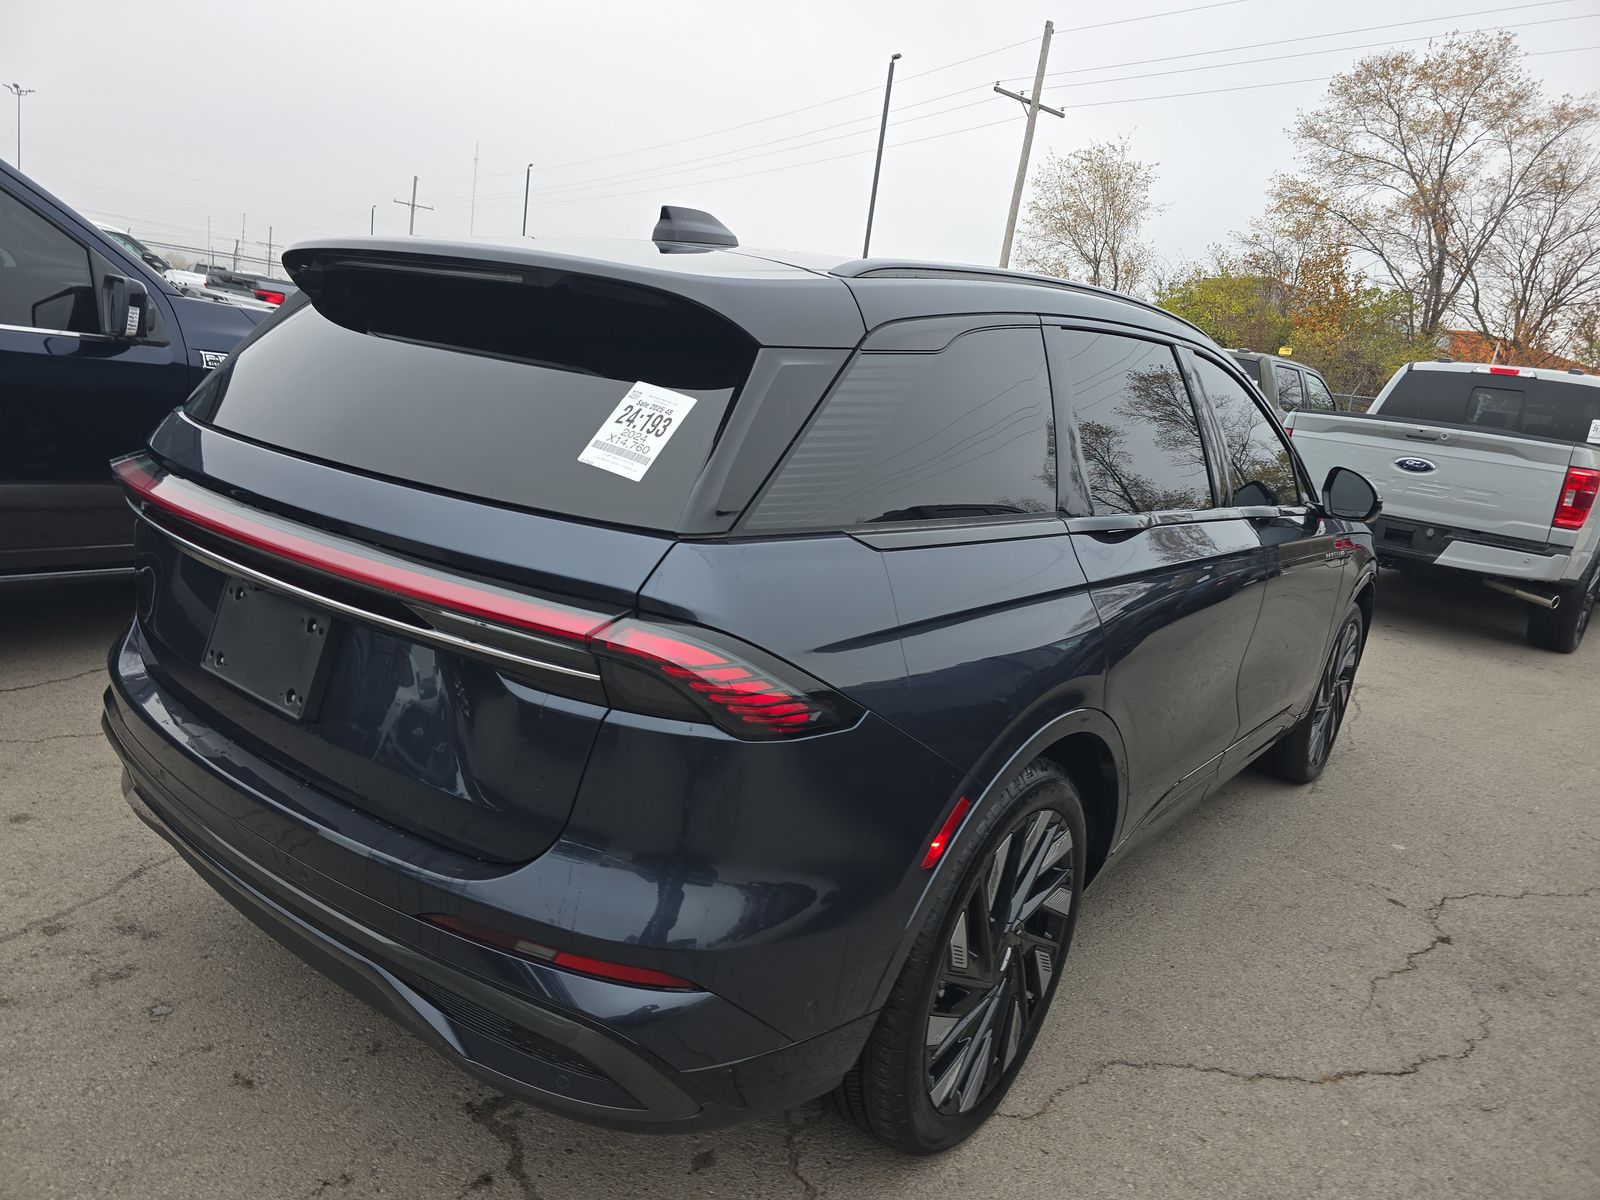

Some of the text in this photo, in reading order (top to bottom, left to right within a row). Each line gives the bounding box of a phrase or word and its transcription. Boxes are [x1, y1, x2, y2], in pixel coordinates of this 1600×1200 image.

[636, 400, 650, 409] Sale
[649, 403, 665, 413] 2025
[615, 405, 673, 437] 24:193
[606, 434, 651, 454] X14.760
[621, 428, 648, 443] 2024
